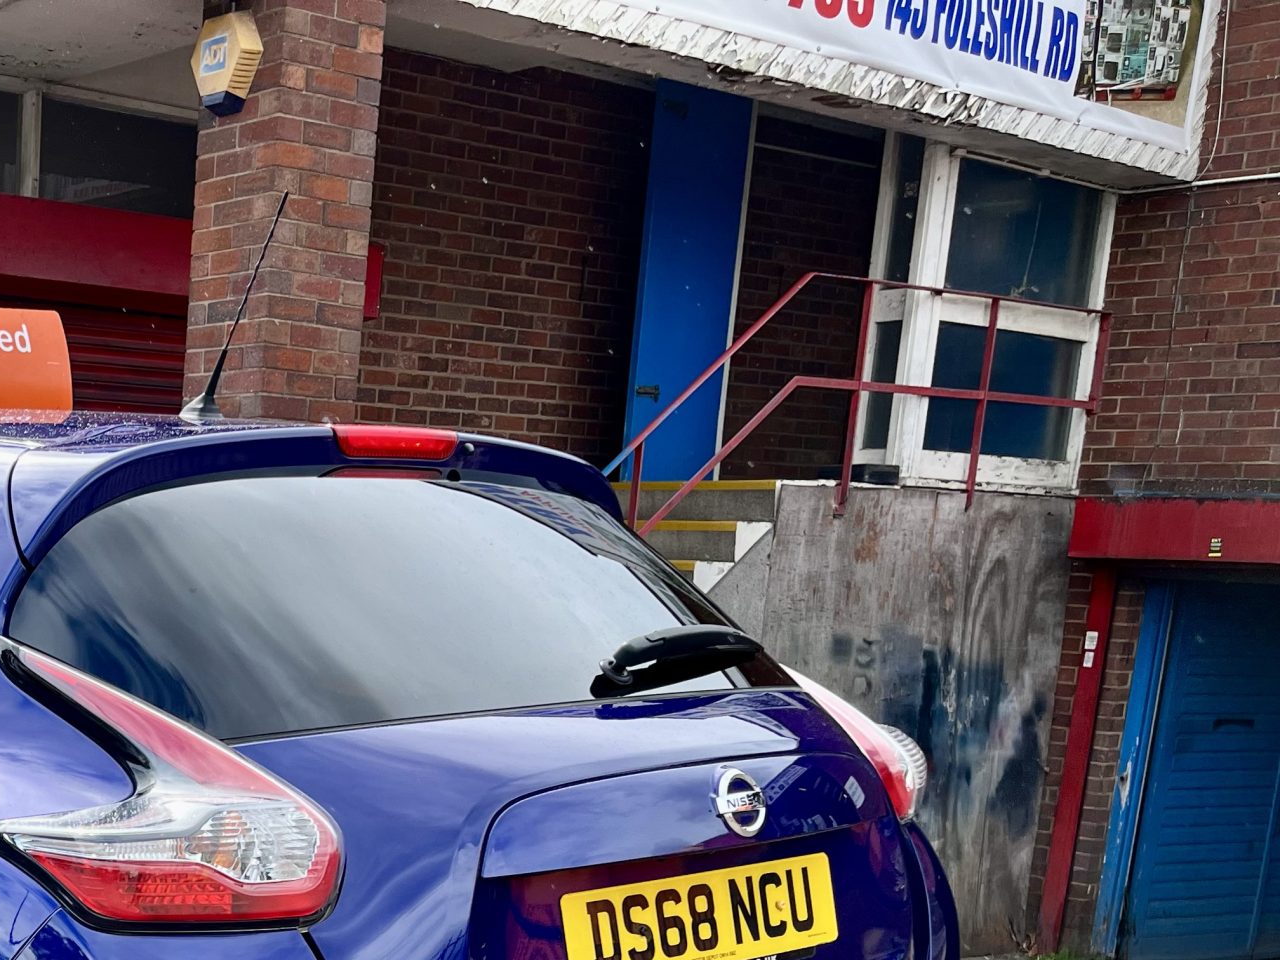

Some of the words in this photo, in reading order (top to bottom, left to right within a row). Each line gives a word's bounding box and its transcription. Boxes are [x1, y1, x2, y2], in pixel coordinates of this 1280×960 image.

[202, 43, 227, 66] ADT
[1043, 6, 1079, 82] RD
[727, 866, 815, 945] NCU
